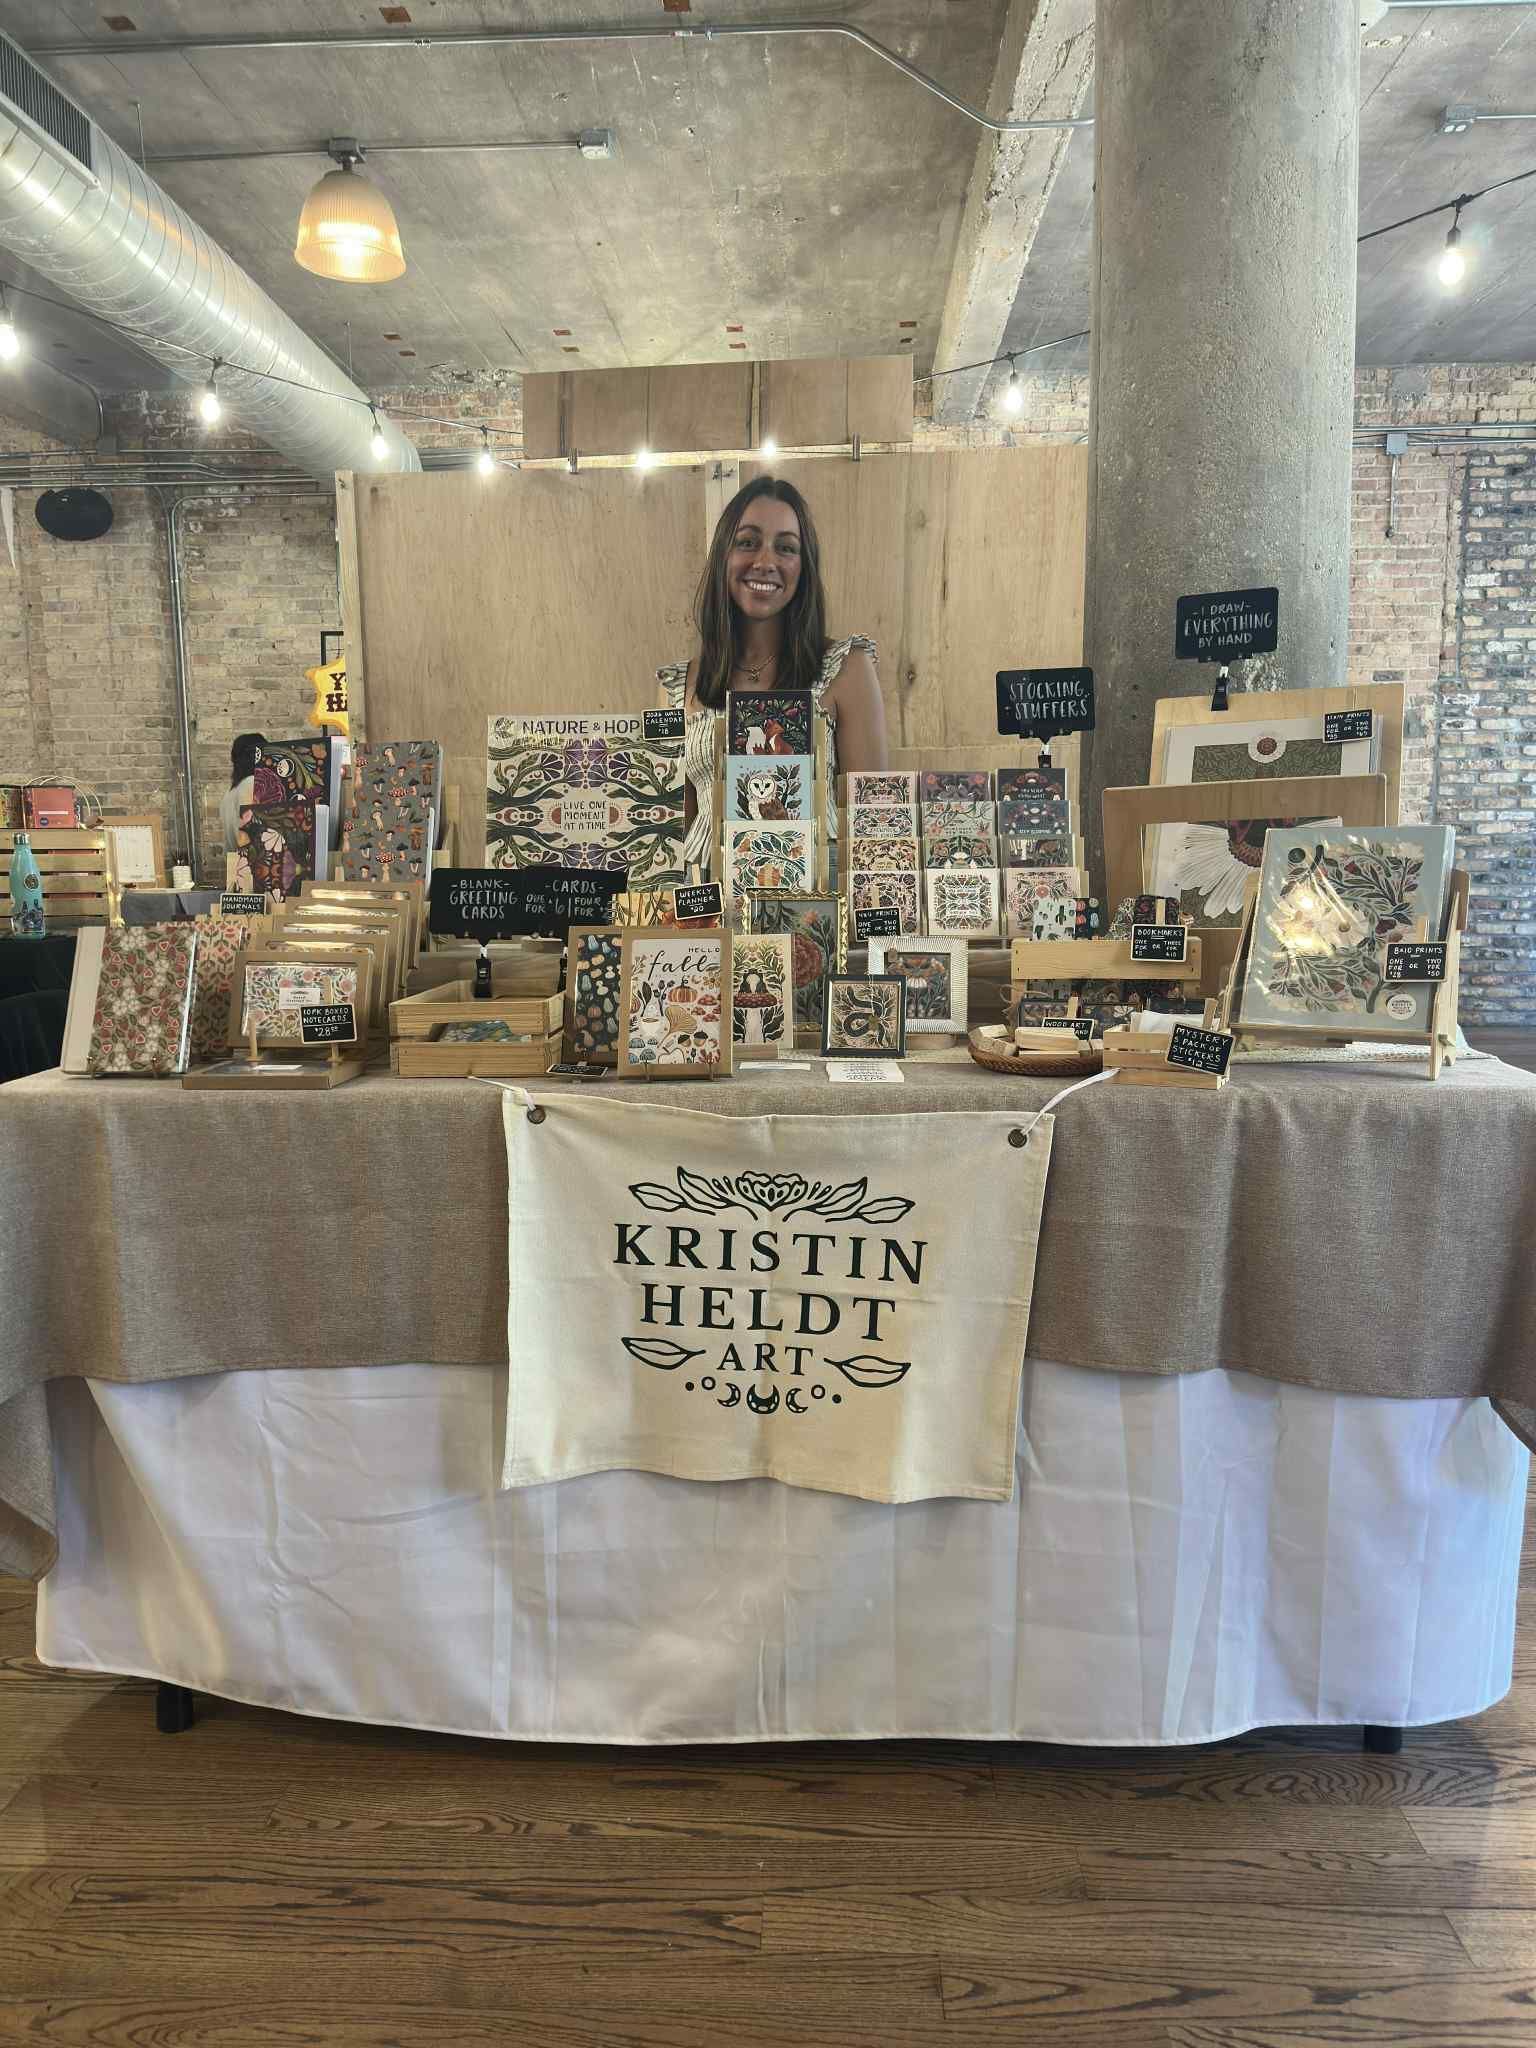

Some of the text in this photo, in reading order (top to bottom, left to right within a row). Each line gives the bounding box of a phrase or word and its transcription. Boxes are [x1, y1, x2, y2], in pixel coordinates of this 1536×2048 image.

[1184, 611, 1273, 637] EVERYTHING
[1199, 633, 1253, 649] BY HAND
[1009, 680, 1084, 701] STOCKING
[1015, 699, 1088, 720] STUFFERS
[522, 720, 588, 734] NATURE
[592, 723, 600, 732] &
[645, 716, 683, 725] CALENDAR
[563, 800, 608, 810] LIVE ONE
[563, 811, 605, 820] MOMENT
[563, 821, 606, 831] AT A TIME
[450, 890, 518, 905] GREETING
[679, 887, 712, 898] WEEKLY
[574, 896, 601, 906] FOUR
[678, 895, 713, 907] PLANNER
[461, 905, 505, 920] CARDS
[525, 903, 546, 914] FOR
[574, 906, 595, 917] FOR
[1137, 929, 1183, 937] BOOKMARKS
[647, 950, 719, 981] fall
[303, 1014, 347, 1024] NOTECARDS
[1176, 1027, 1229, 1047] MYSTERY
[1182, 1038, 1206, 1050] PACK
[1172, 1045, 1221, 1064] STICKERS
[613, 1223, 928, 1285] KRISTIN
[640, 1283, 896, 1342] HELDT
[716, 1343, 813, 1376] ART
